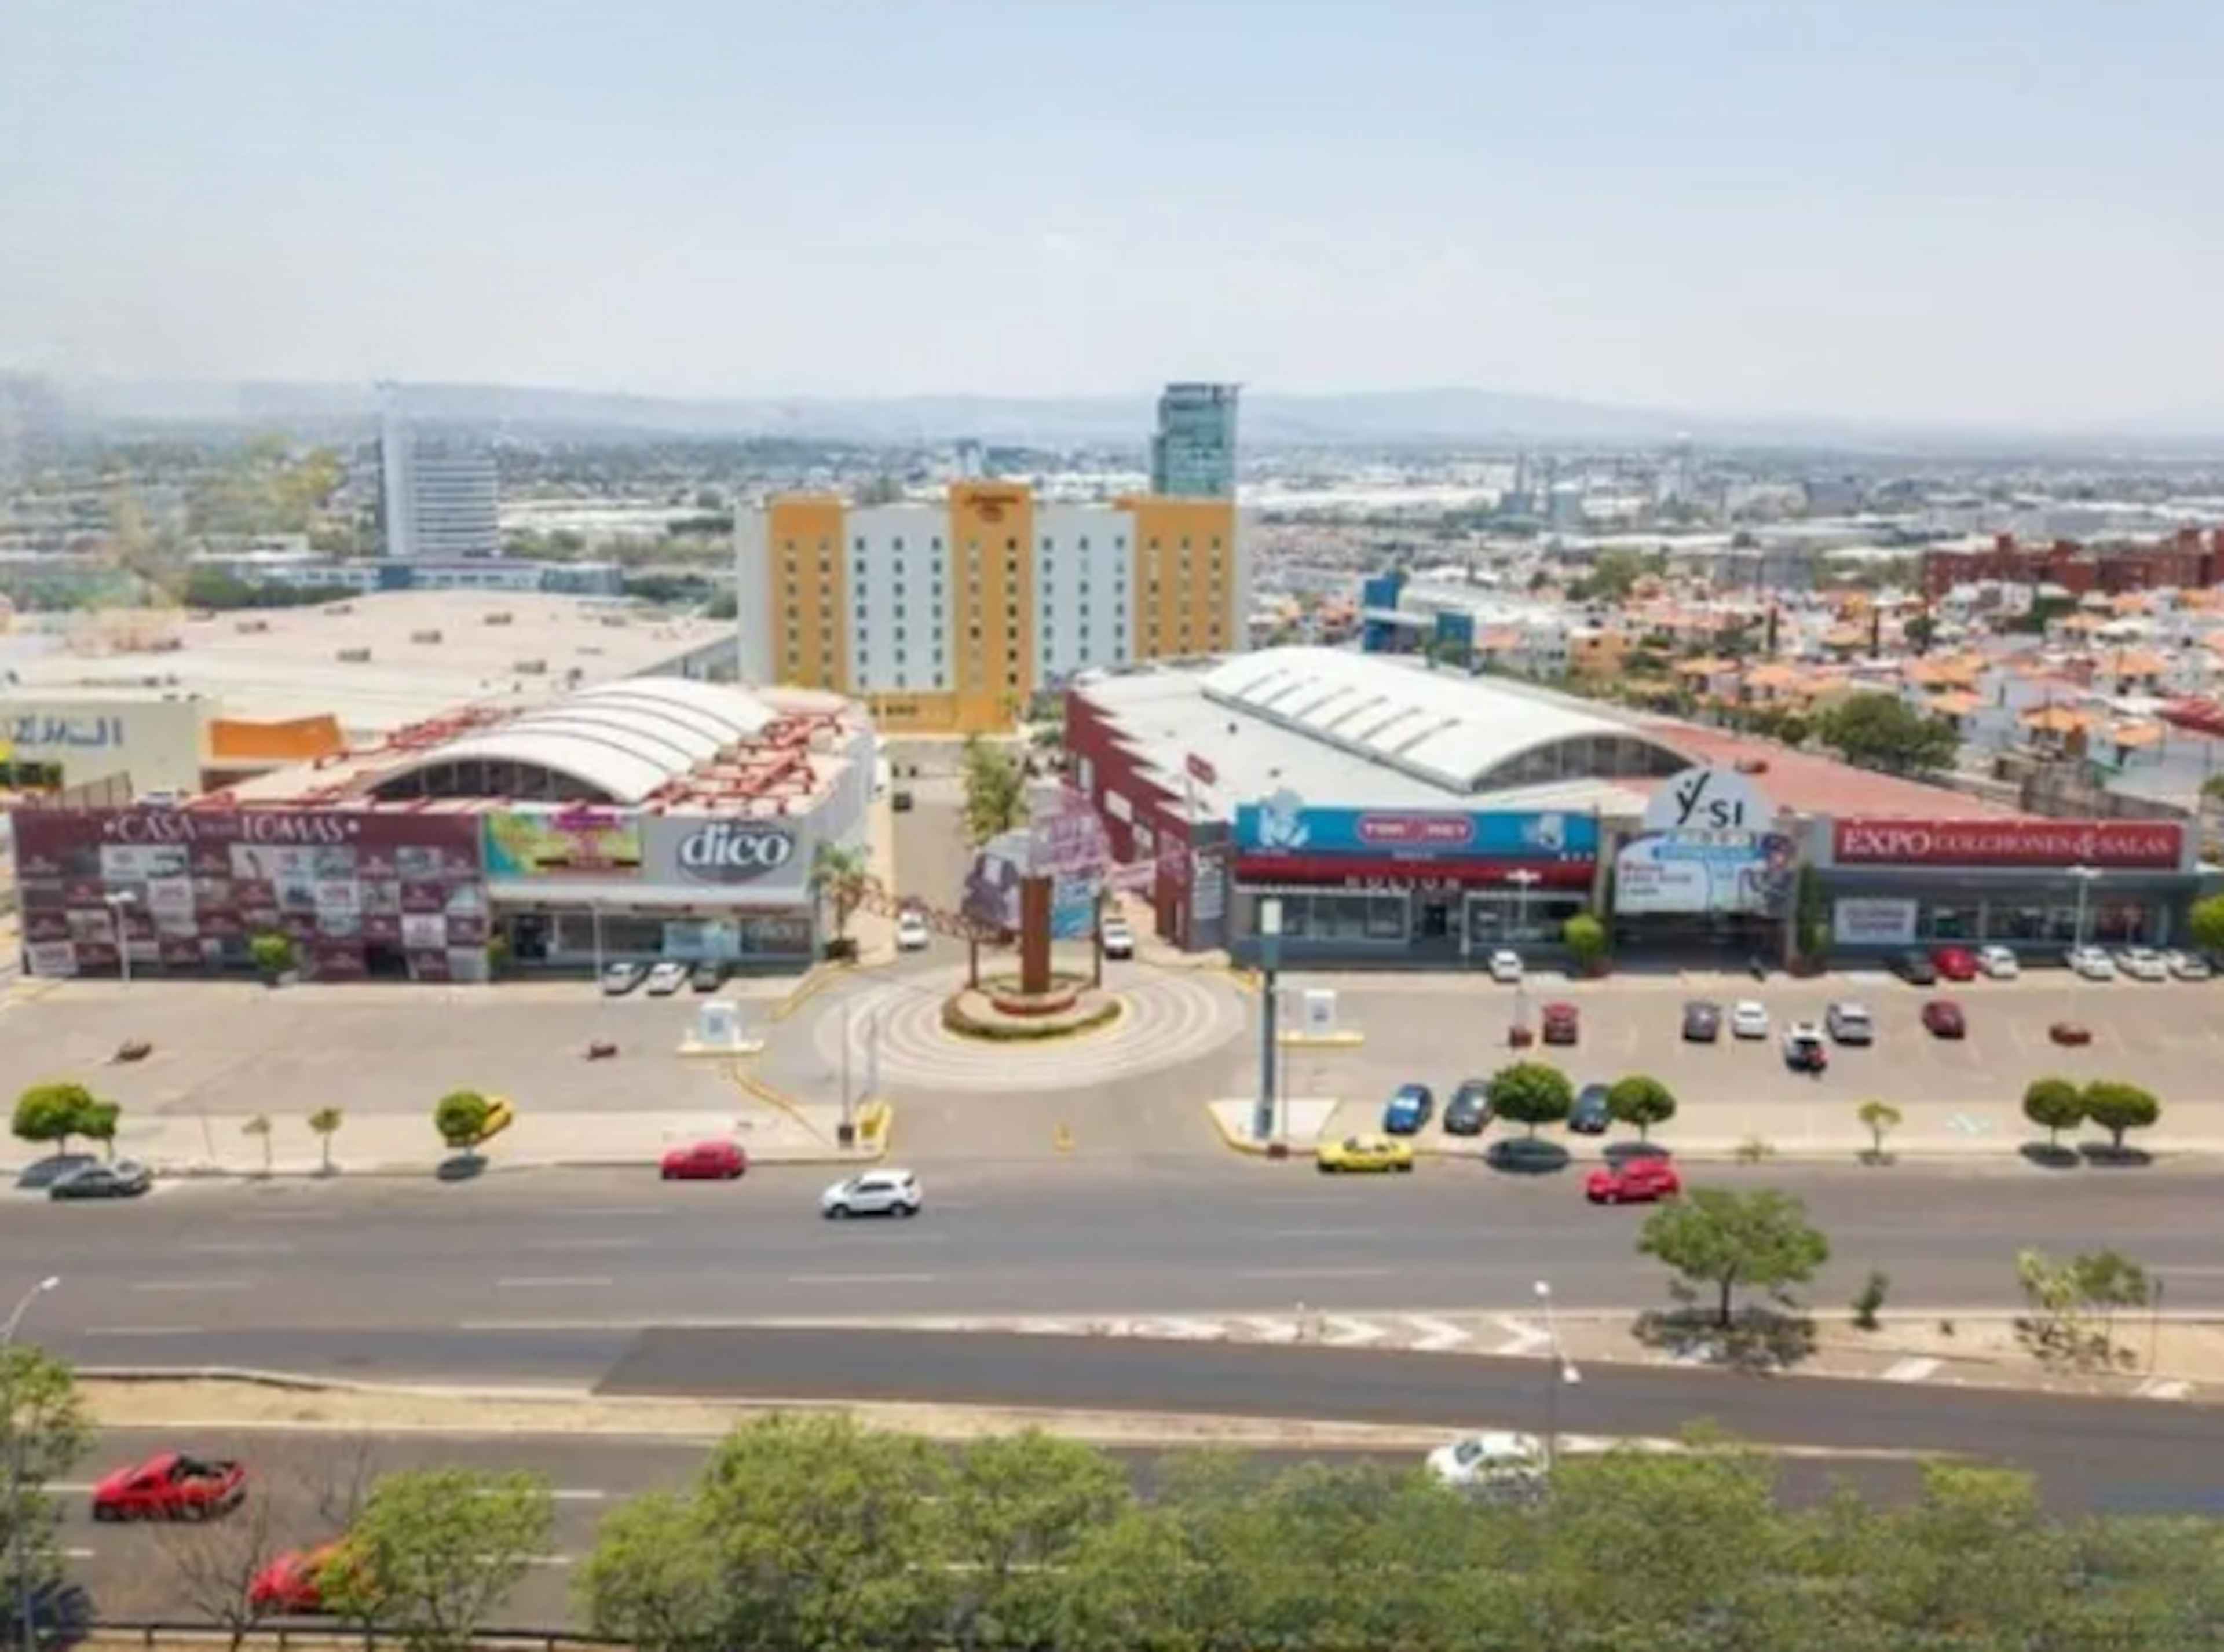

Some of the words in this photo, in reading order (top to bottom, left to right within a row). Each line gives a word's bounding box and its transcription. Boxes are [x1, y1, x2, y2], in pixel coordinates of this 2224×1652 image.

[118, 814, 196, 841] CASA
[682, 823, 790, 865] dico
[1843, 830, 1932, 854] EXPO
